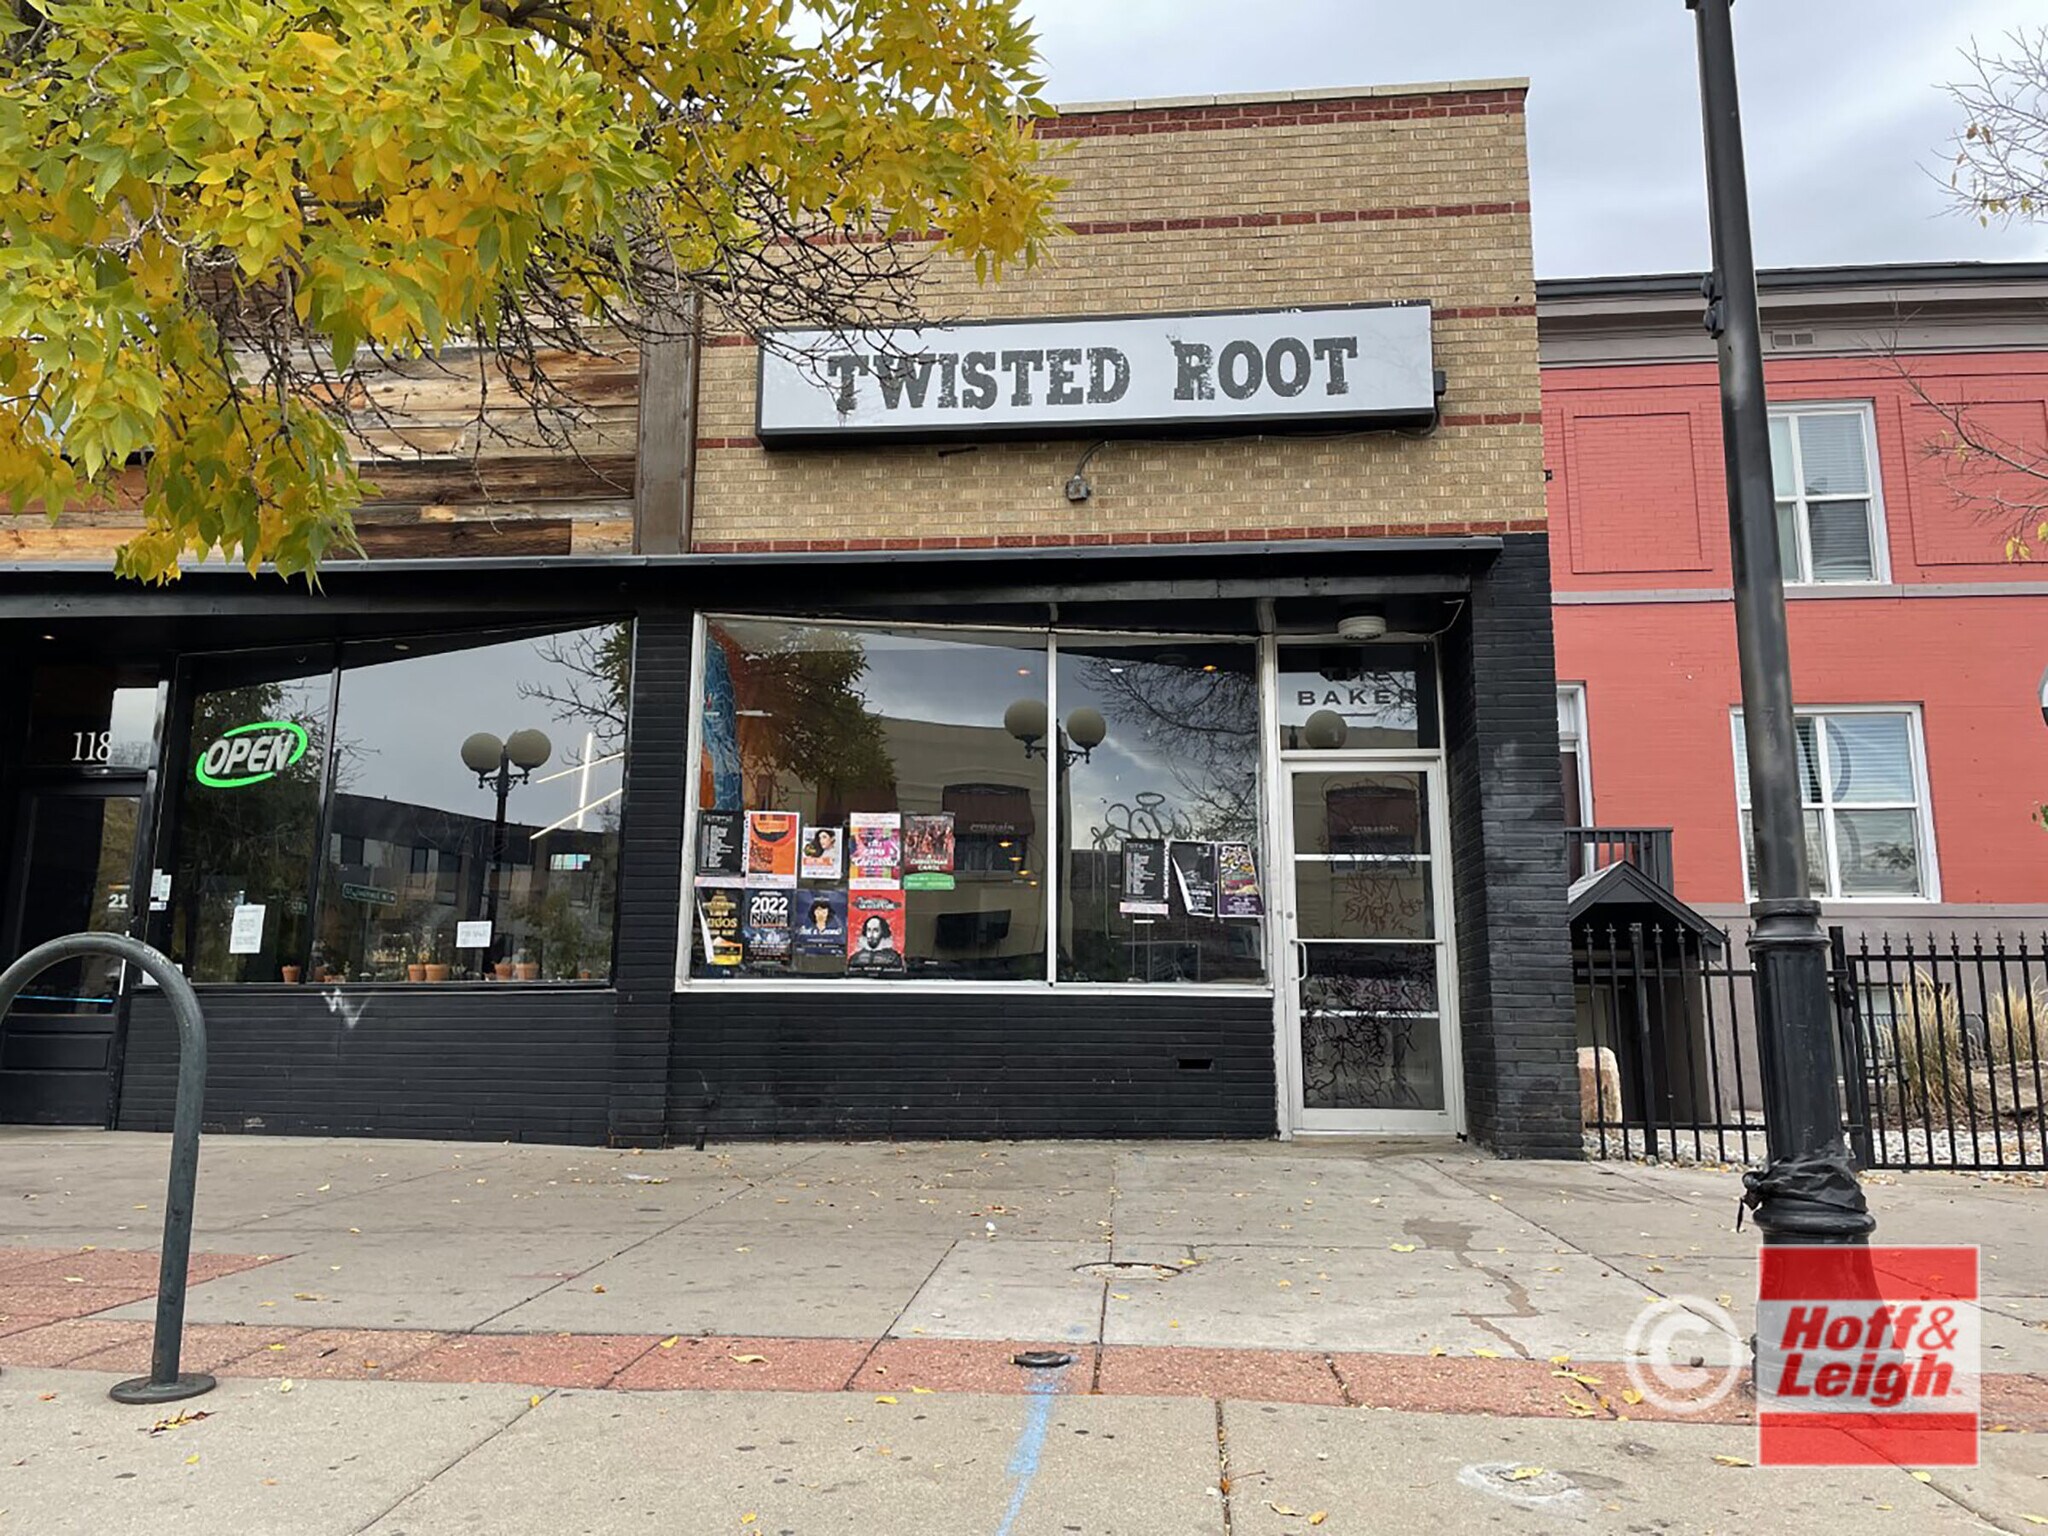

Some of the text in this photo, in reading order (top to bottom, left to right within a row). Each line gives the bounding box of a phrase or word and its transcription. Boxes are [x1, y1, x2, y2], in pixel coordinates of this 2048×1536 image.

[827, 336, 1358, 411] TWISTED ROOT
[1297, 689, 1417, 706] BAKER
[71, 731, 112, 761] 118
[205, 733, 295, 775] OPEN
[107, 894, 128, 908] 21
[751, 897, 788, 914] 2022
